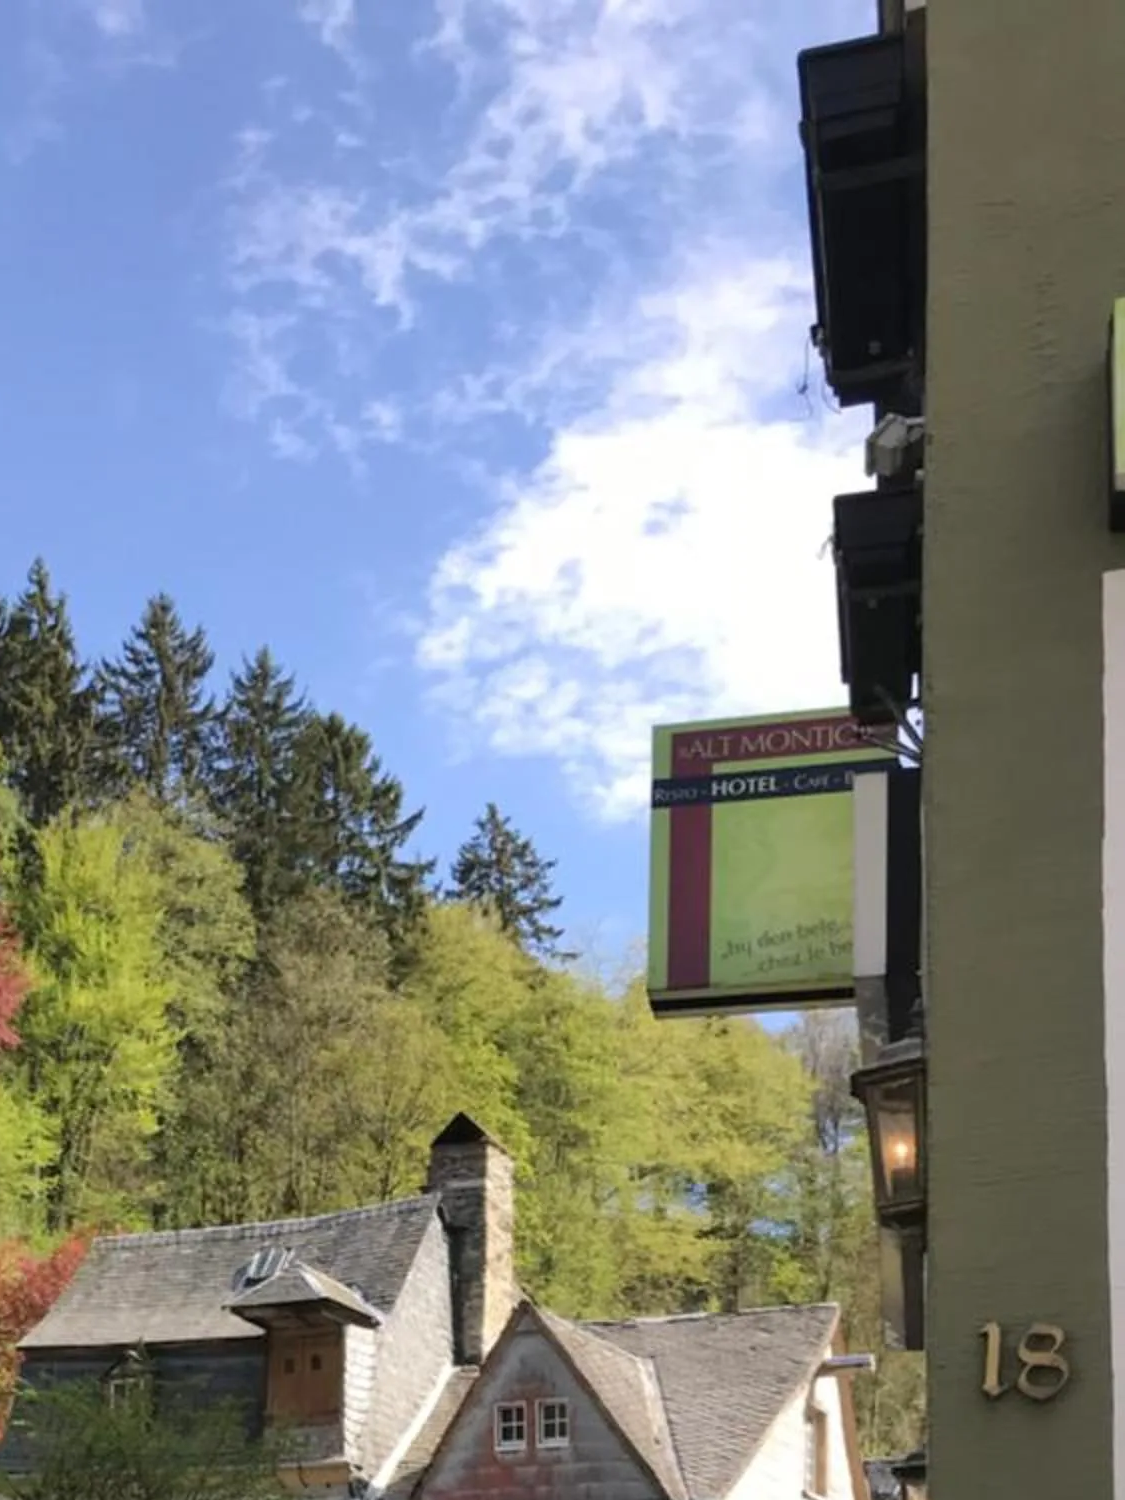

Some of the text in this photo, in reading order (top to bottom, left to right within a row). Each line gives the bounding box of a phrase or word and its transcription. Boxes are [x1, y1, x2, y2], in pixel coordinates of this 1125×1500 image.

[739, 722, 860, 754] MONTJO
[711, 776, 781, 798] HOTEL
[978, 1320, 1070, 1400] 18
